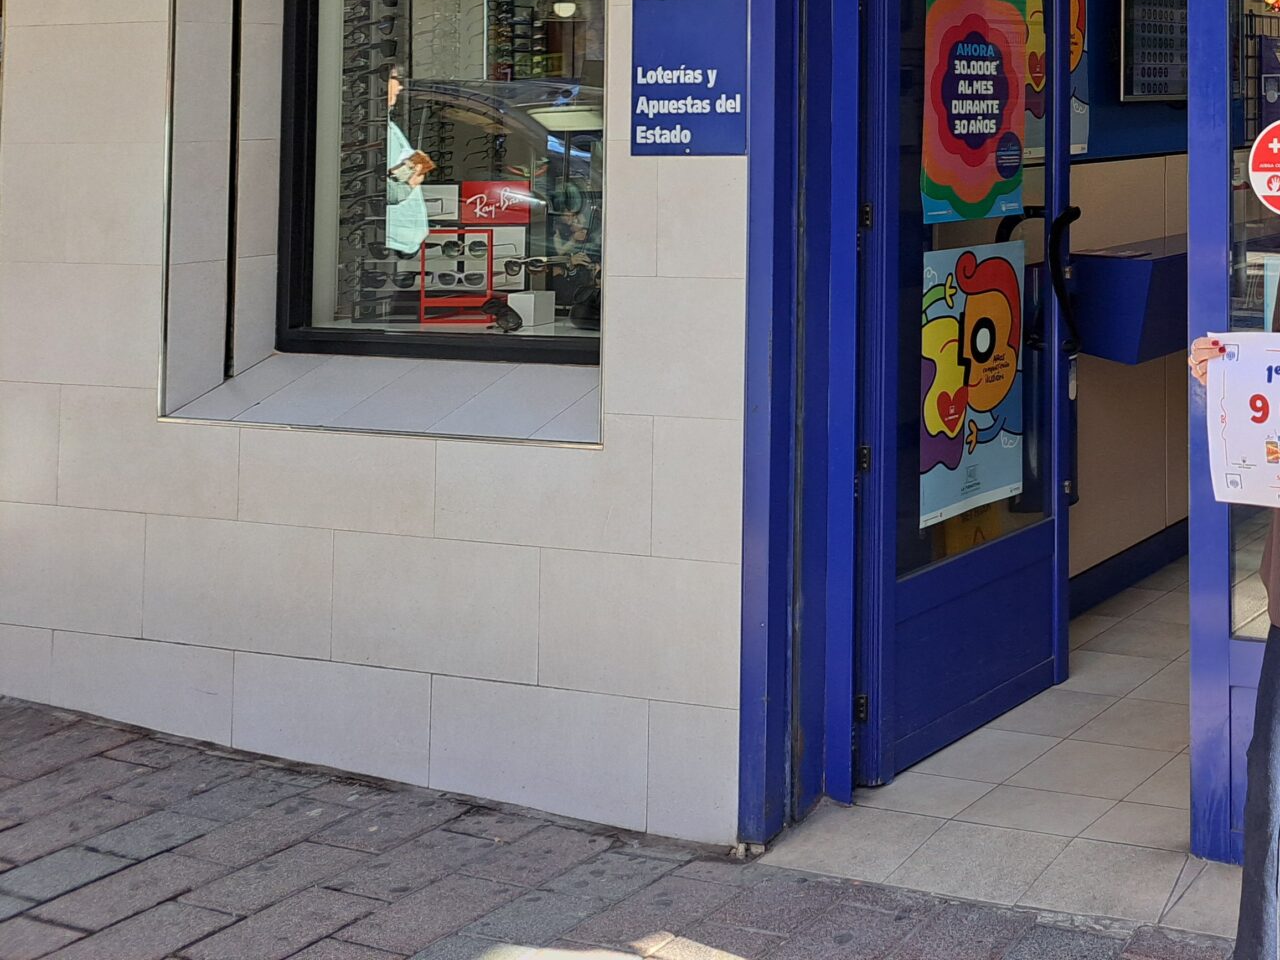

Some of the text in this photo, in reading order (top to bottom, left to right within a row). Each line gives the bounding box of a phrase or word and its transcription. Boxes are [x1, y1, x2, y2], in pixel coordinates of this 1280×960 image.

[957, 43, 994, 56] AHORA
[637, 65, 717, 88] Loterías y
[958, 80, 993, 95] AL MES
[636, 94, 741, 117] Apuestas del
[952, 100, 999, 114] DURANTE
[636, 125, 691, 143] Estado
[954, 116, 996, 134] 30 AÑOS
[465, 187, 522, 218] Ray-Ba
